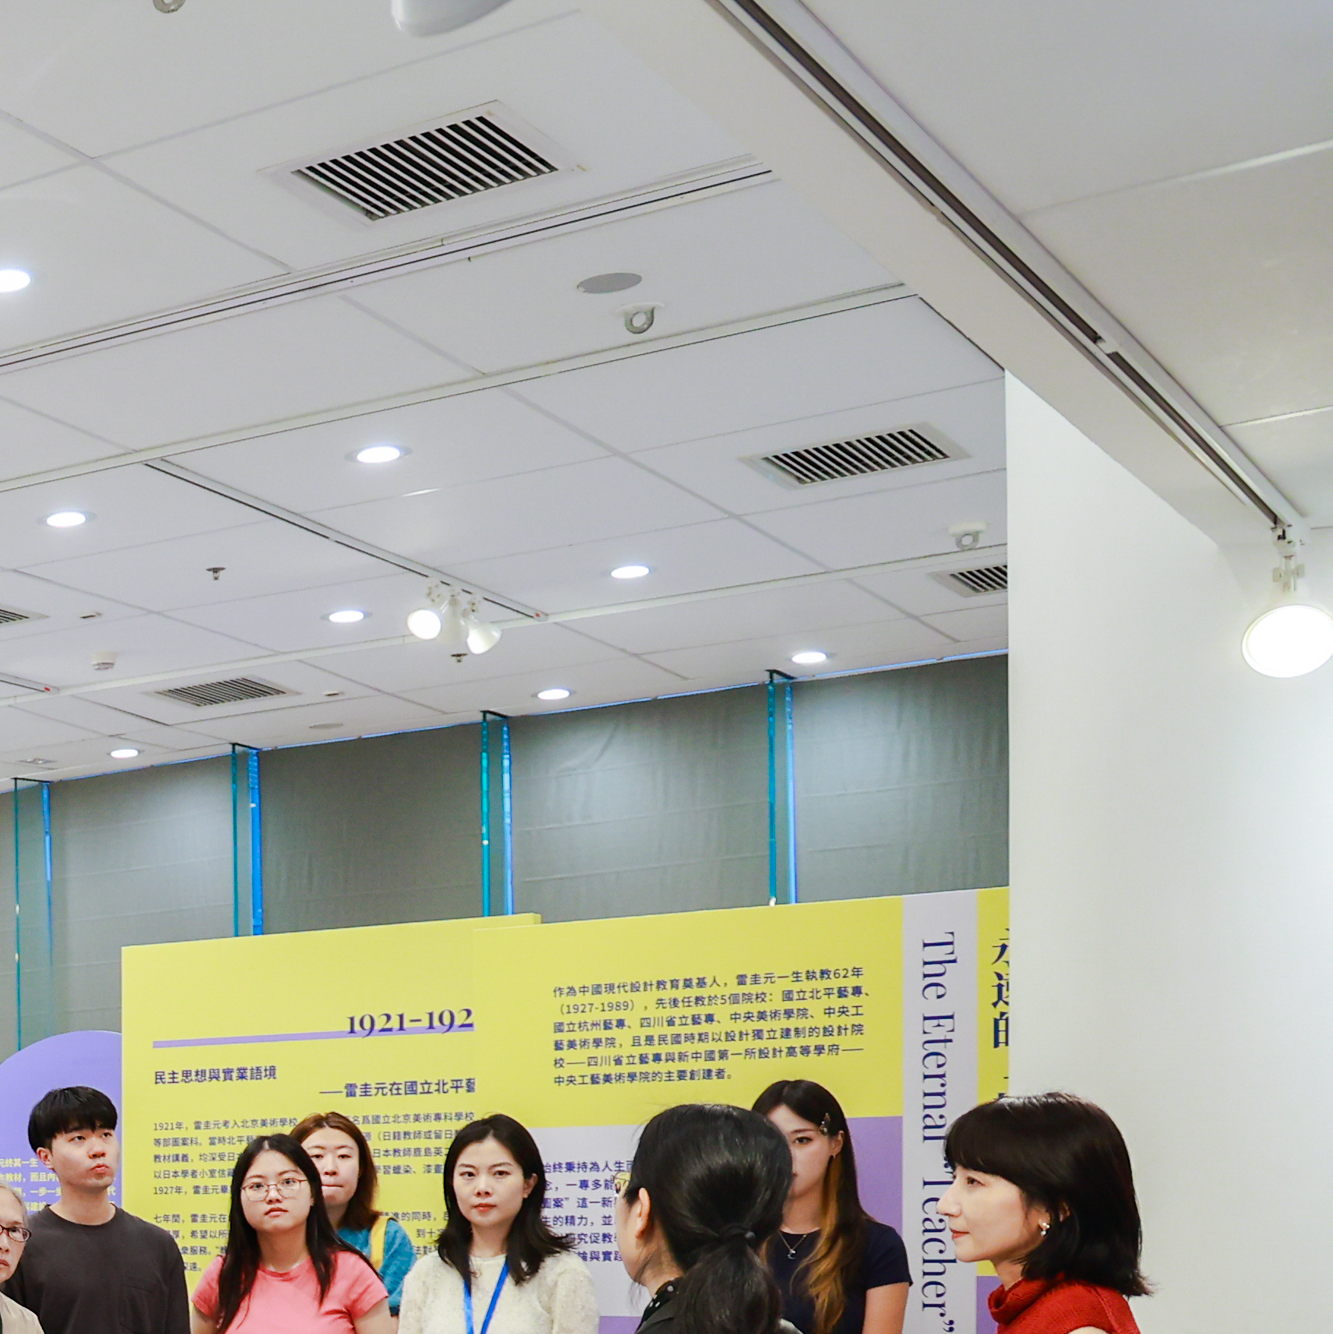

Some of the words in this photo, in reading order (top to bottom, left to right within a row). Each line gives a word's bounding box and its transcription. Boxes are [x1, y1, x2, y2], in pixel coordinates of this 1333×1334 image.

[922, 931, 958, 1000] The
[154, 1065, 277, 1085] 民主思想與實業語境
[922, 1011, 955, 1144] Eternal
